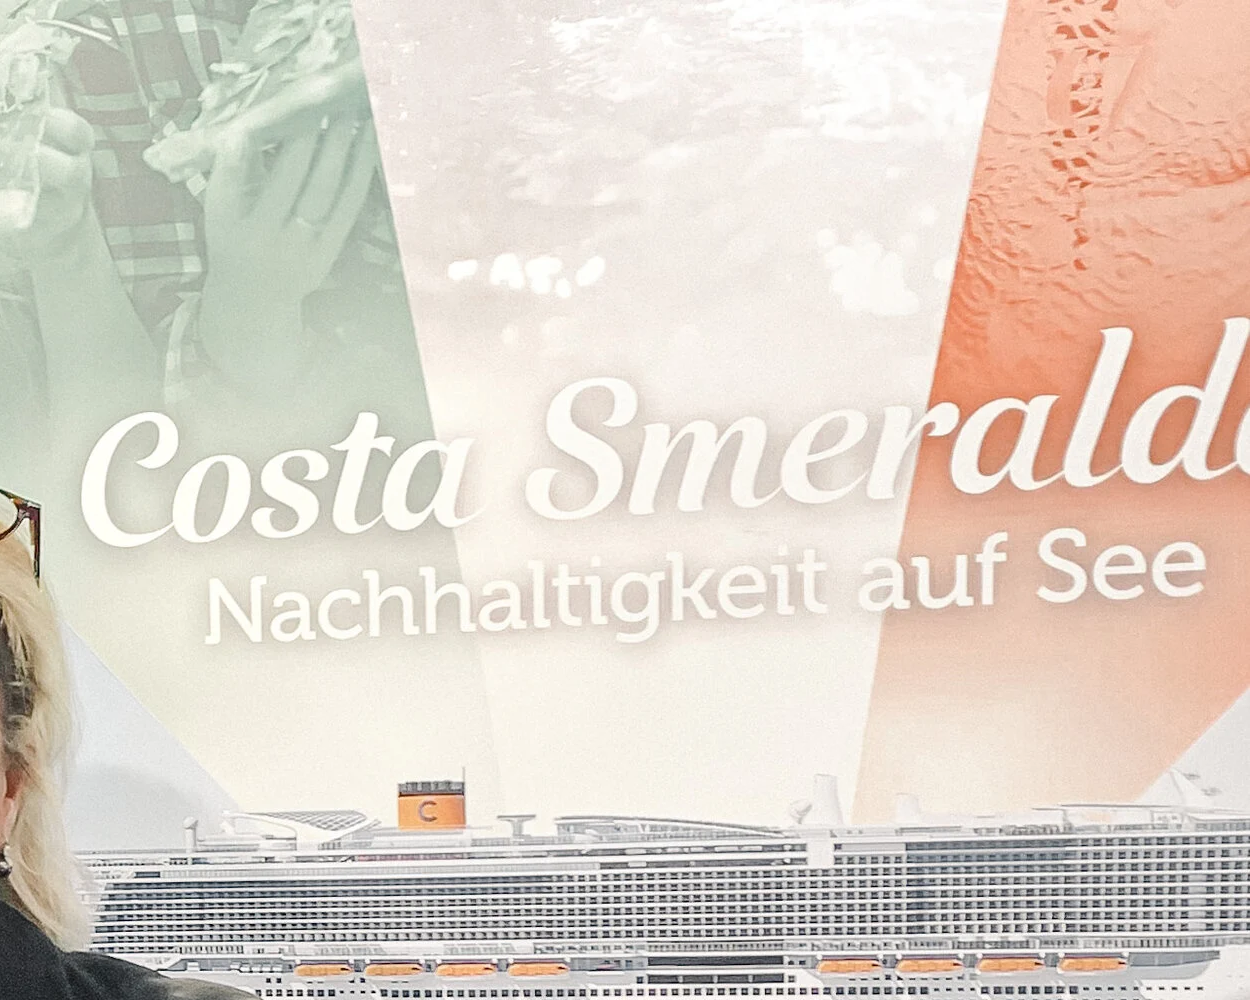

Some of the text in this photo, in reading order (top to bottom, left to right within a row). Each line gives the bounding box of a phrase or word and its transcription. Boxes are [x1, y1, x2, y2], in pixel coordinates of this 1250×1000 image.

[80, 317, 1250, 548] Costa Smerald
[205, 526, 1207, 645] Nachhaltigkeit auf See
[417, 800, 438, 823] C
